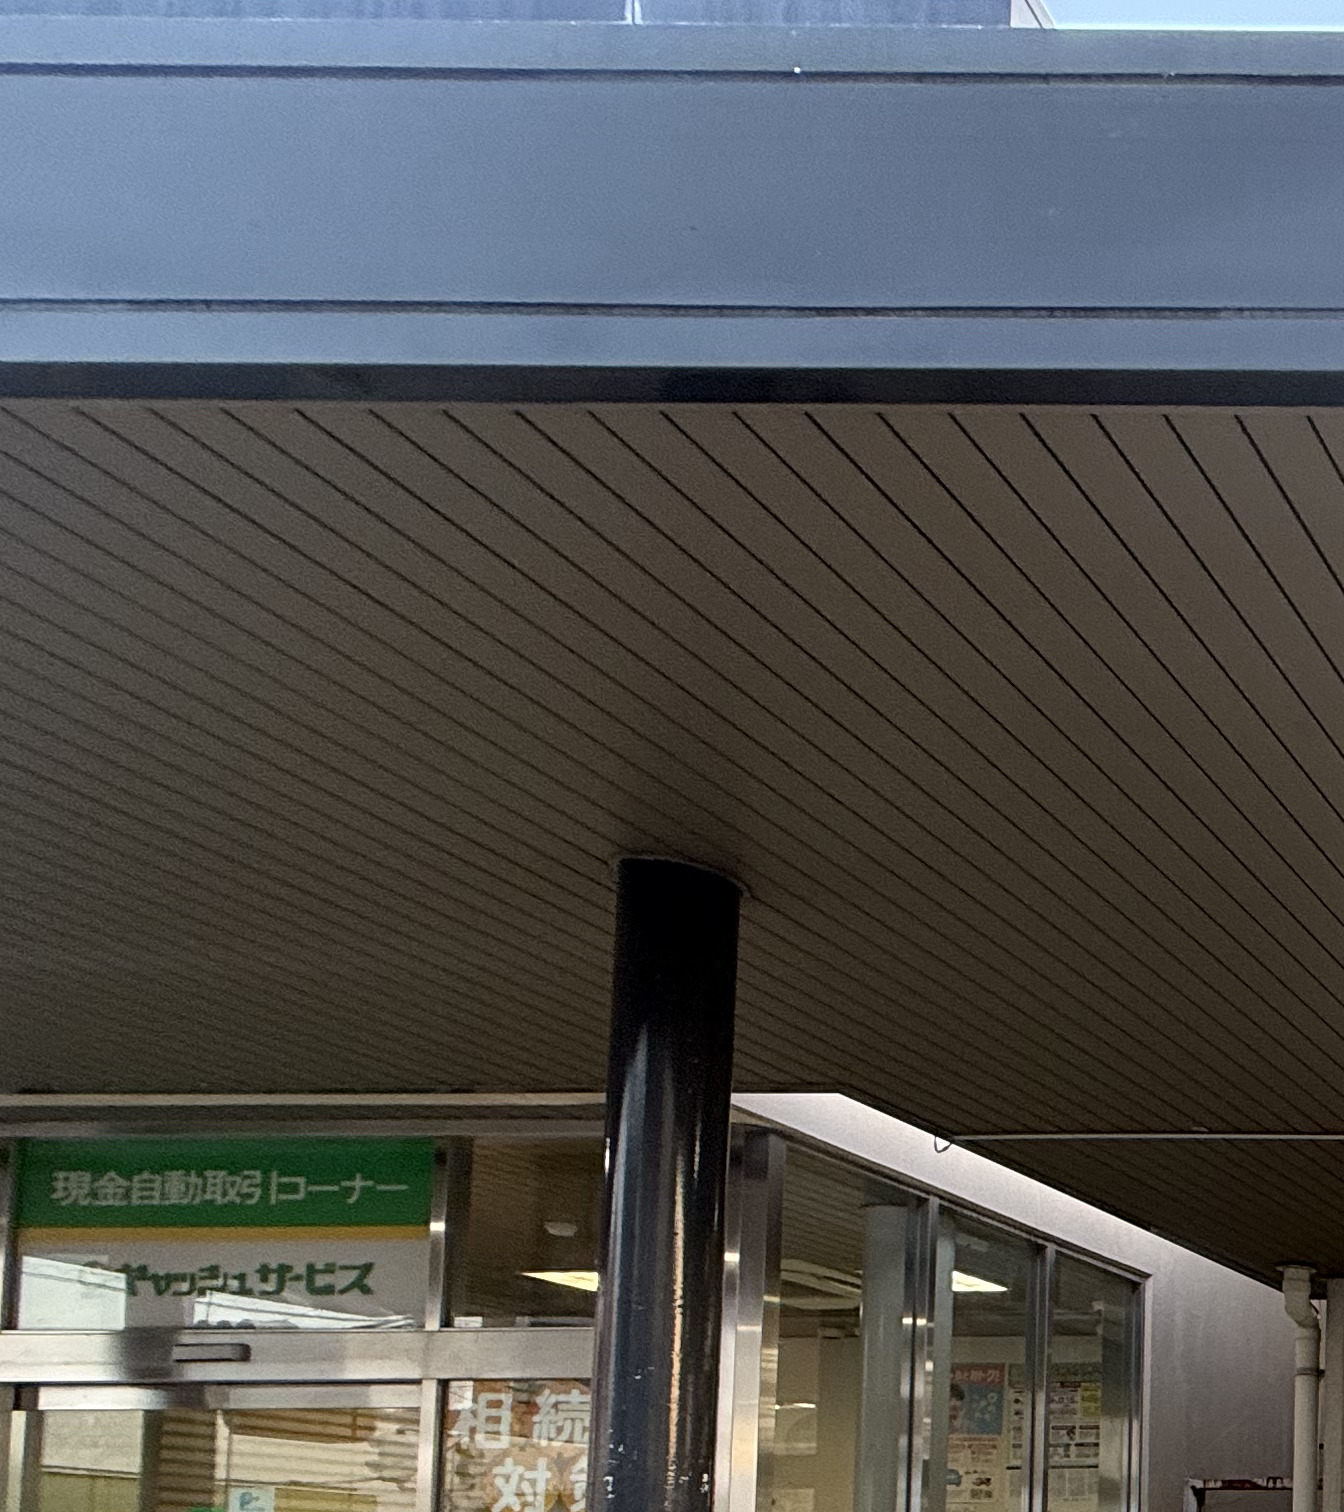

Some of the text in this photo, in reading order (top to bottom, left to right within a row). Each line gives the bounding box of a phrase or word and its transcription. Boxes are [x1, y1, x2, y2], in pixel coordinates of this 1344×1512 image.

[50, 1170, 409, 1206] 現金自動取引コーナー
[117, 1261, 375, 1297] キャッシュサービス
[447, 1388, 592, 1450] 相続
